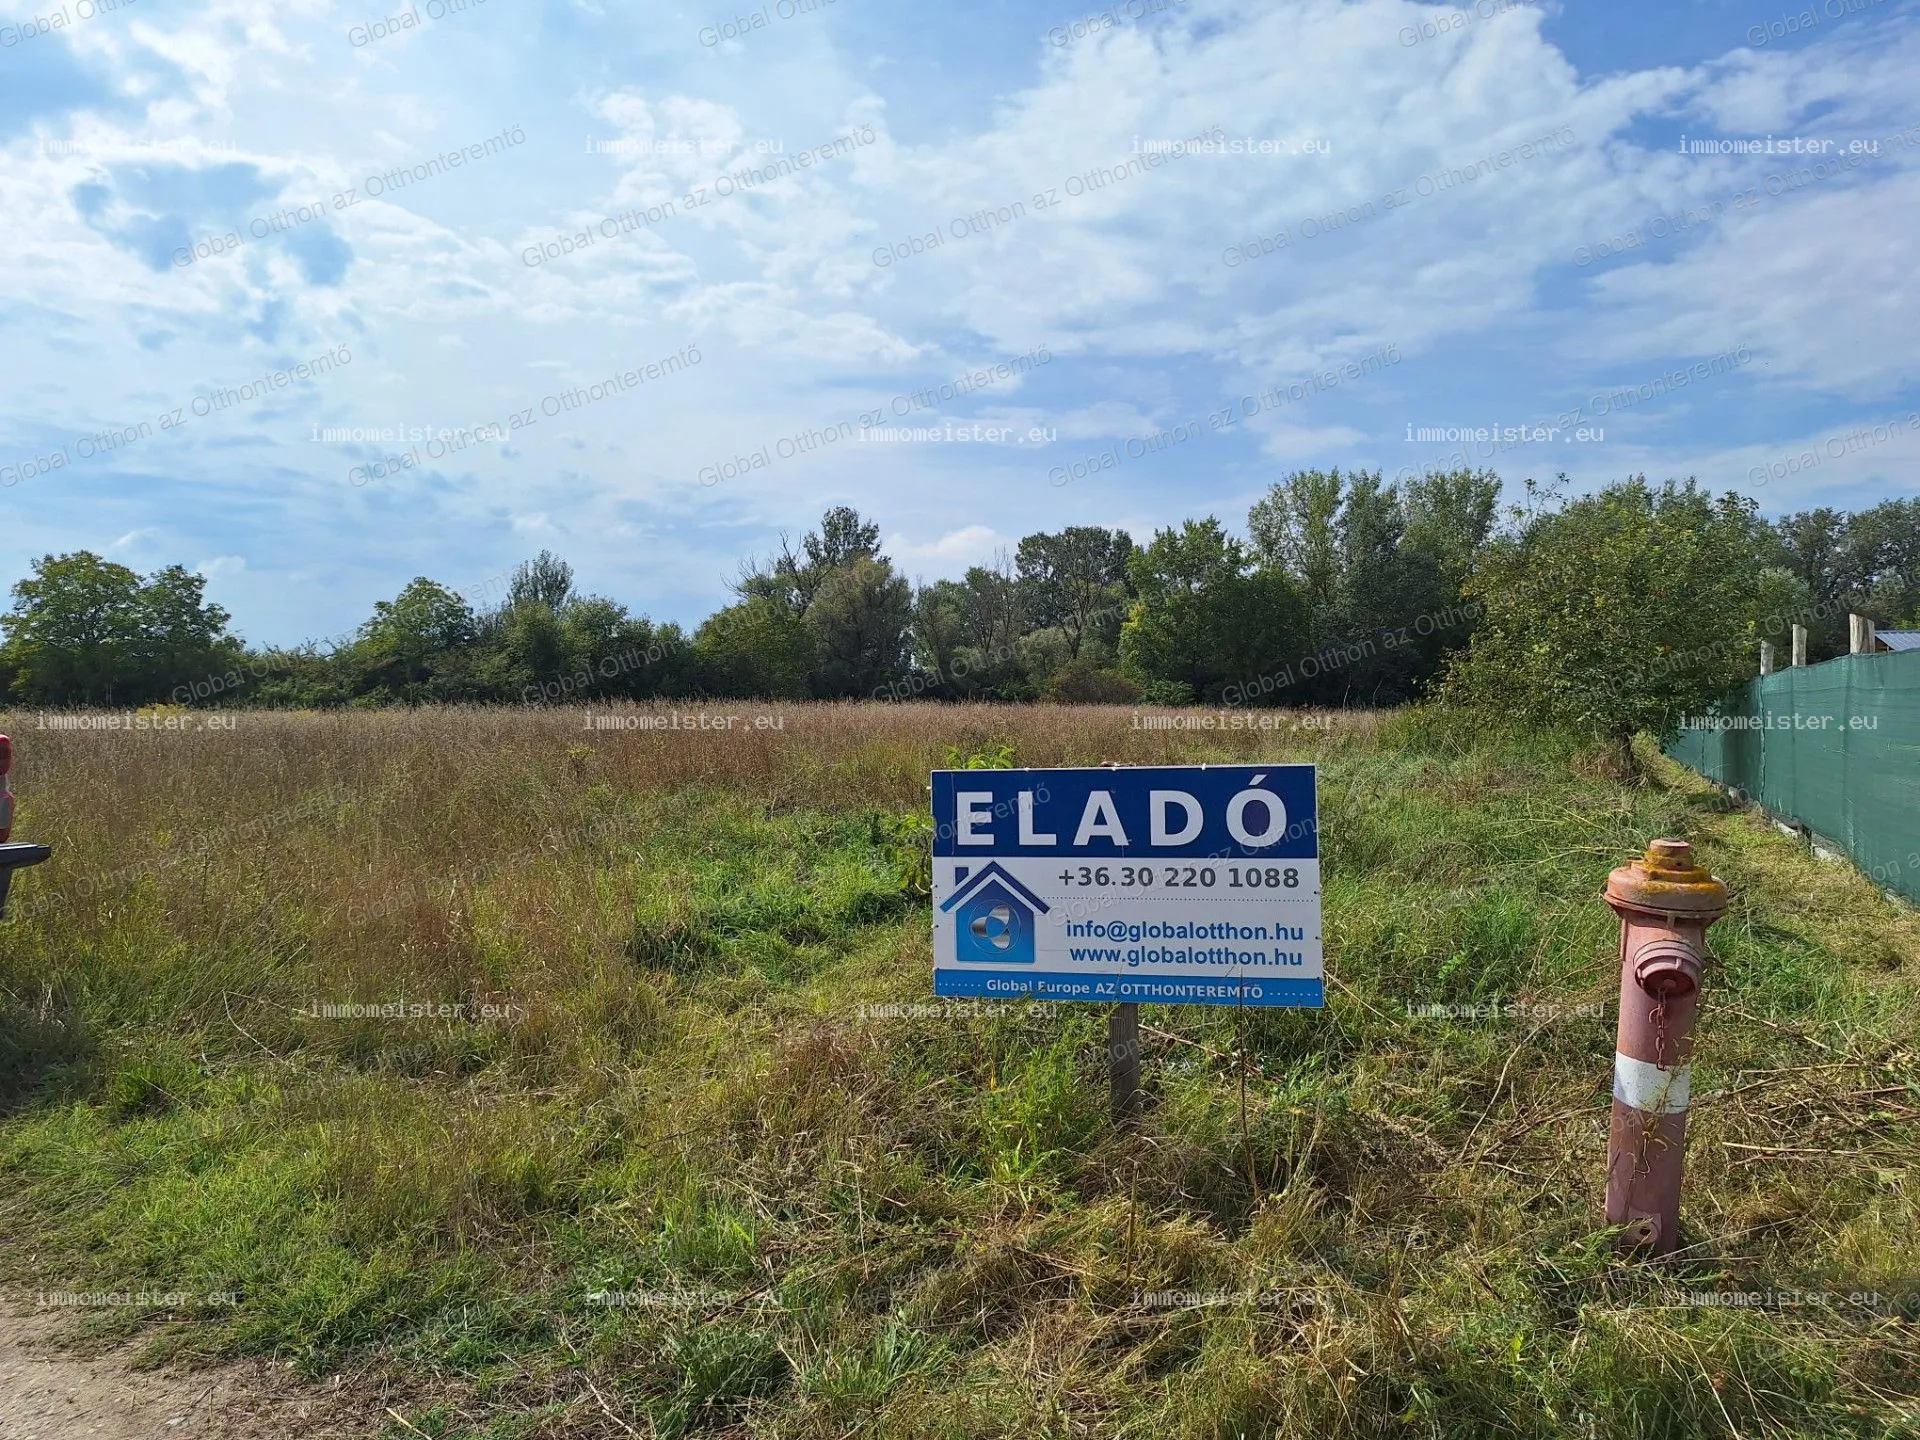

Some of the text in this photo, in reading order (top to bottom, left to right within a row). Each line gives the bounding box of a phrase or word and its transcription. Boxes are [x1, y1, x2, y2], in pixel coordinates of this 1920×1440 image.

[956, 774, 1287, 848] ELADÓ
[1058, 867, 1300, 889] +36.30 220 1088
[1066, 920, 1304, 943] info@globalotthon.hu
[1070, 946, 1303, 967] www.globalotthon.hu
[986, 979, 1033, 992] Global
[1038, 981, 1090, 996] Europe
[1095, 983, 1116, 995] AZ
